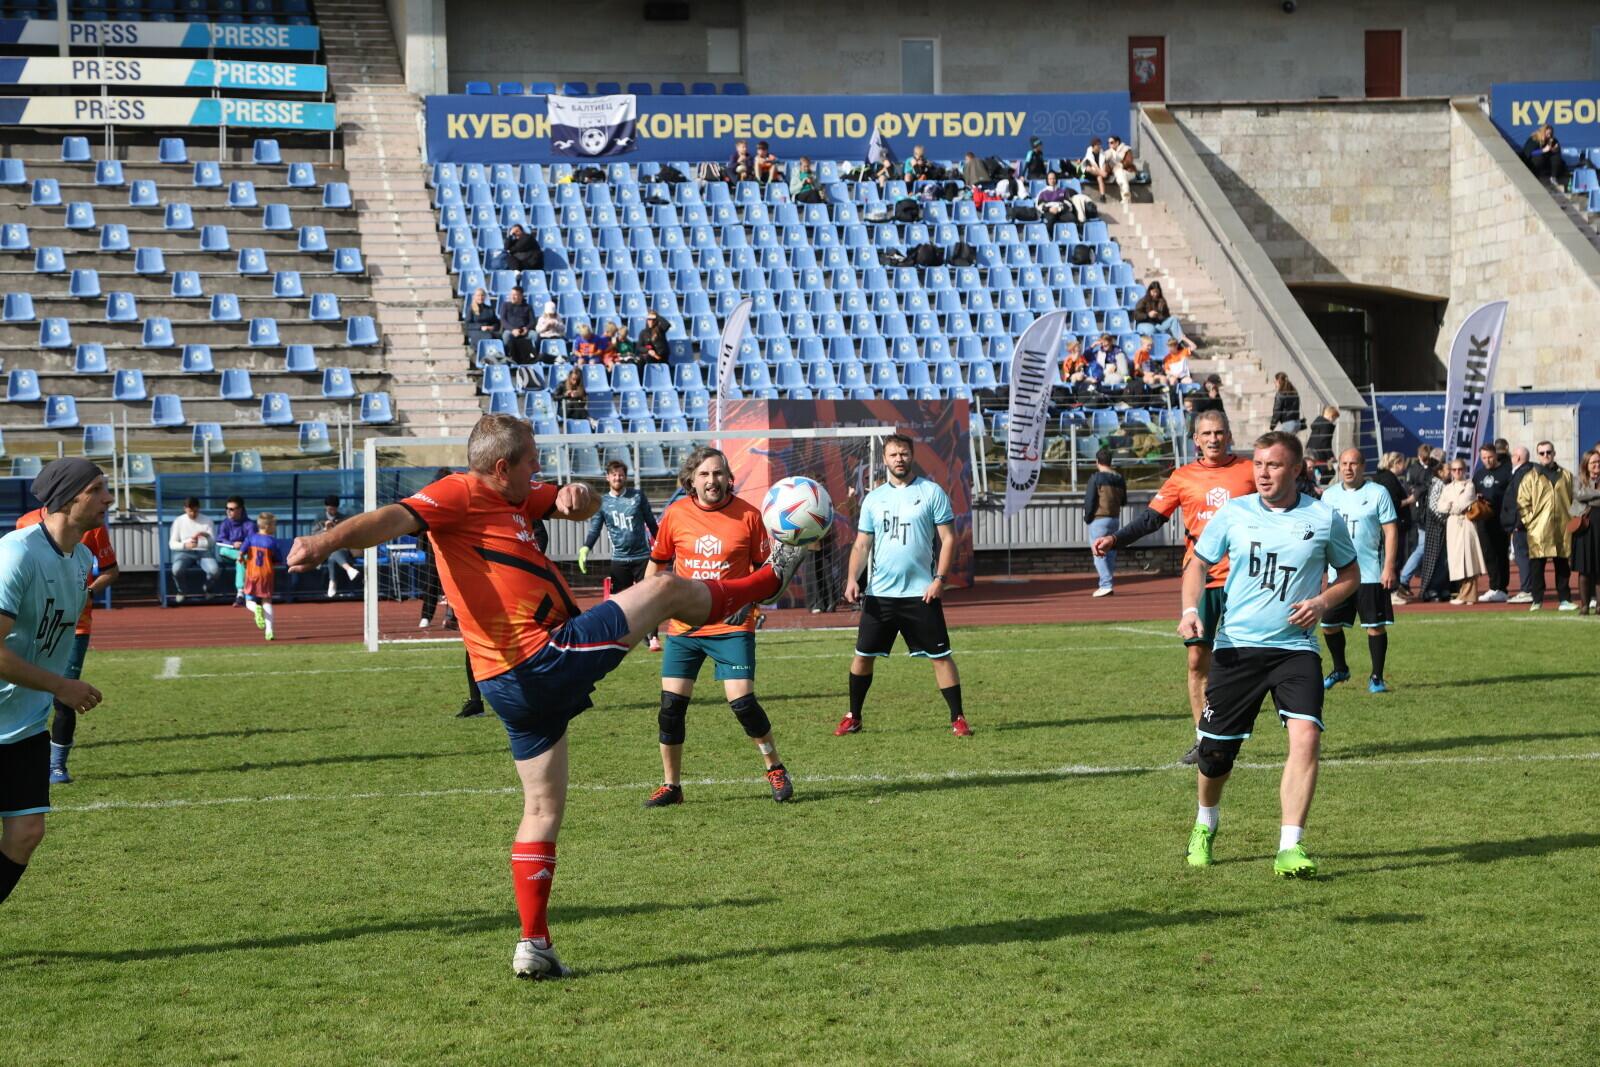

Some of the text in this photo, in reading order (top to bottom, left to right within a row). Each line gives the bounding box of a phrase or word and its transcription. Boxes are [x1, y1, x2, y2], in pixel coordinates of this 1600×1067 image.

[70, 23, 290, 47] PRESS PRESSE
[72, 60, 297, 86] PRESS PRESSE
[74, 99, 304, 124] PRESS PRESSE
[447, 113, 552, 139] КУБОК
[823, 113, 868, 138] ПО
[874, 111, 1027, 138] ФУТБОЛУ
[1032, 110, 1111, 136] 2026
[1512, 98, 1600, 126] КУБО
[1010, 350, 1047, 460] ВЕЧЕРНИЙ
[612, 510, 633, 531] БДТ
[883, 510, 911, 545] БДТ
[684, 559, 730, 570] МЕДИА
[692, 570, 720, 580] ДОМ
[1248, 541, 1298, 602] БДТ
[36, 598, 75, 658] БДТ
